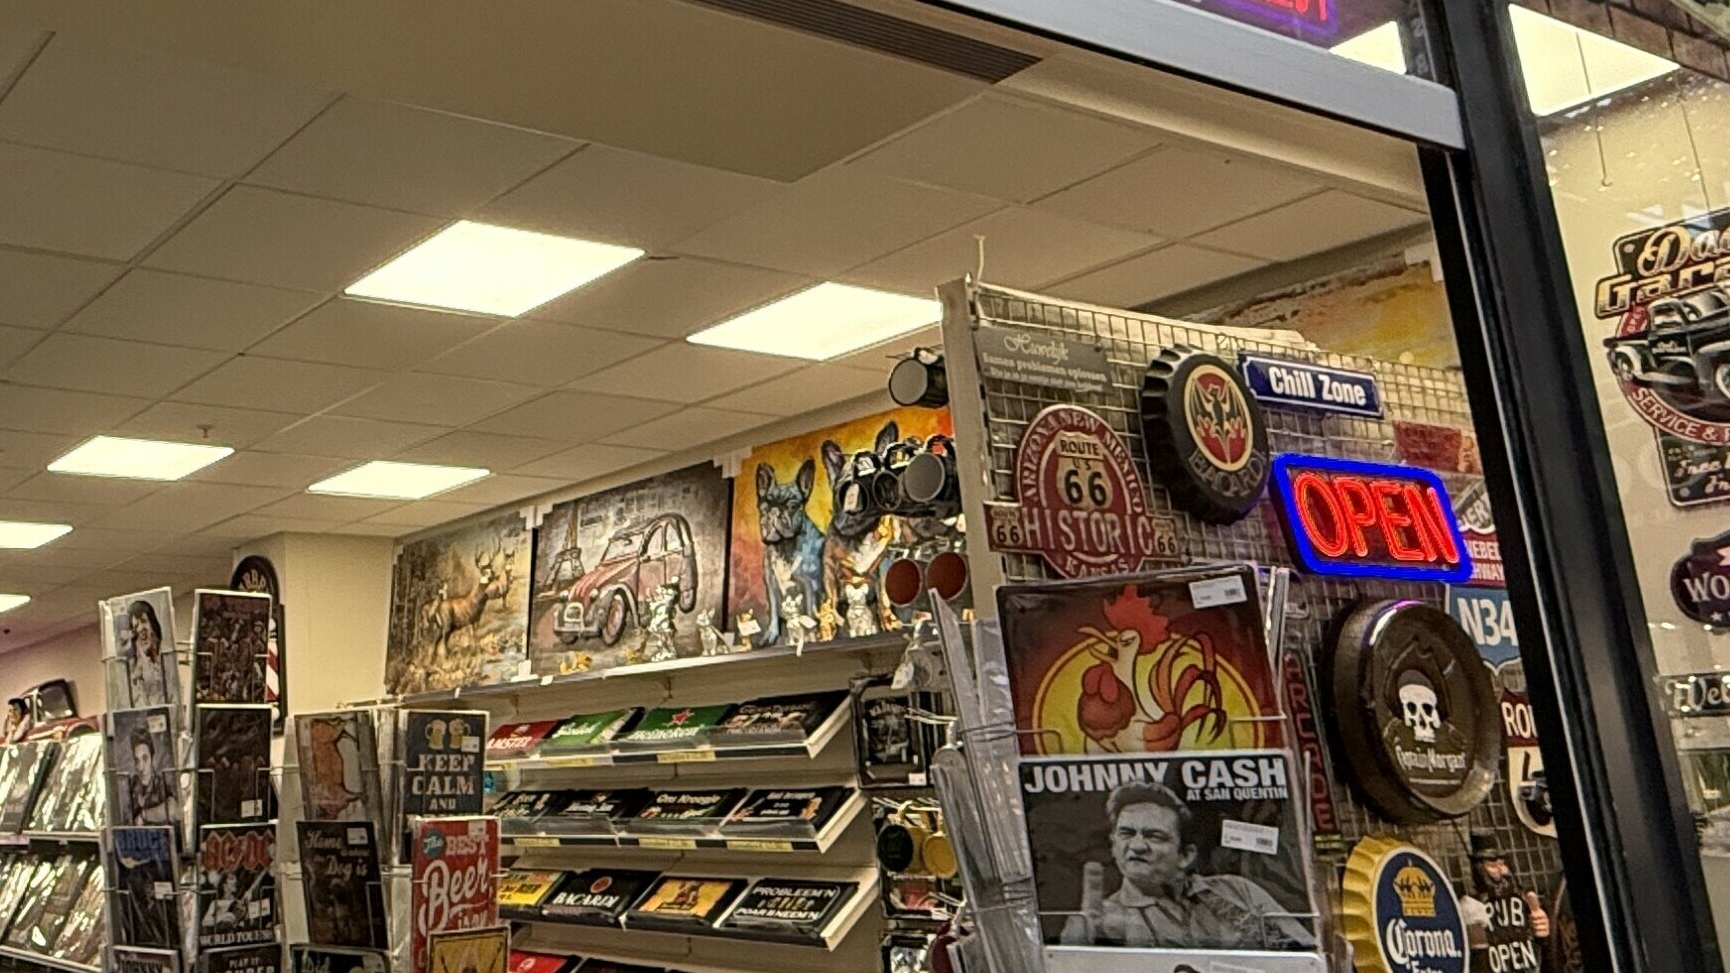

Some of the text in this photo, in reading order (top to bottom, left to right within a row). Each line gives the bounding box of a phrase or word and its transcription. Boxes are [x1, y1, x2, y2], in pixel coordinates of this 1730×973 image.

[1269, 366, 1367, 407] Chill Zone
[1632, 386, 1698, 437] SERVICE
[1060, 439, 1099, 457] ROUTE
[1063, 469, 1108, 507] 66
[1293, 471, 1460, 564] OPEN
[996, 524, 1020, 545] 66
[1022, 506, 1152, 555] HISTORIC
[1157, 536, 1177, 555] 66
[1459, 598, 1519, 647] N34
[418, 754, 476, 772] KEEP
[412, 776, 475, 795] CALM
[1024, 758, 1287, 794] JOHNNY CASH
[429, 798, 457, 811] AND
[1186, 786, 1289, 801] AT SAN QUENTIN
[445, 834, 489, 856] BEST
[552, 891, 620, 908] BACARDI
[1483, 896, 1525, 932] PUB
